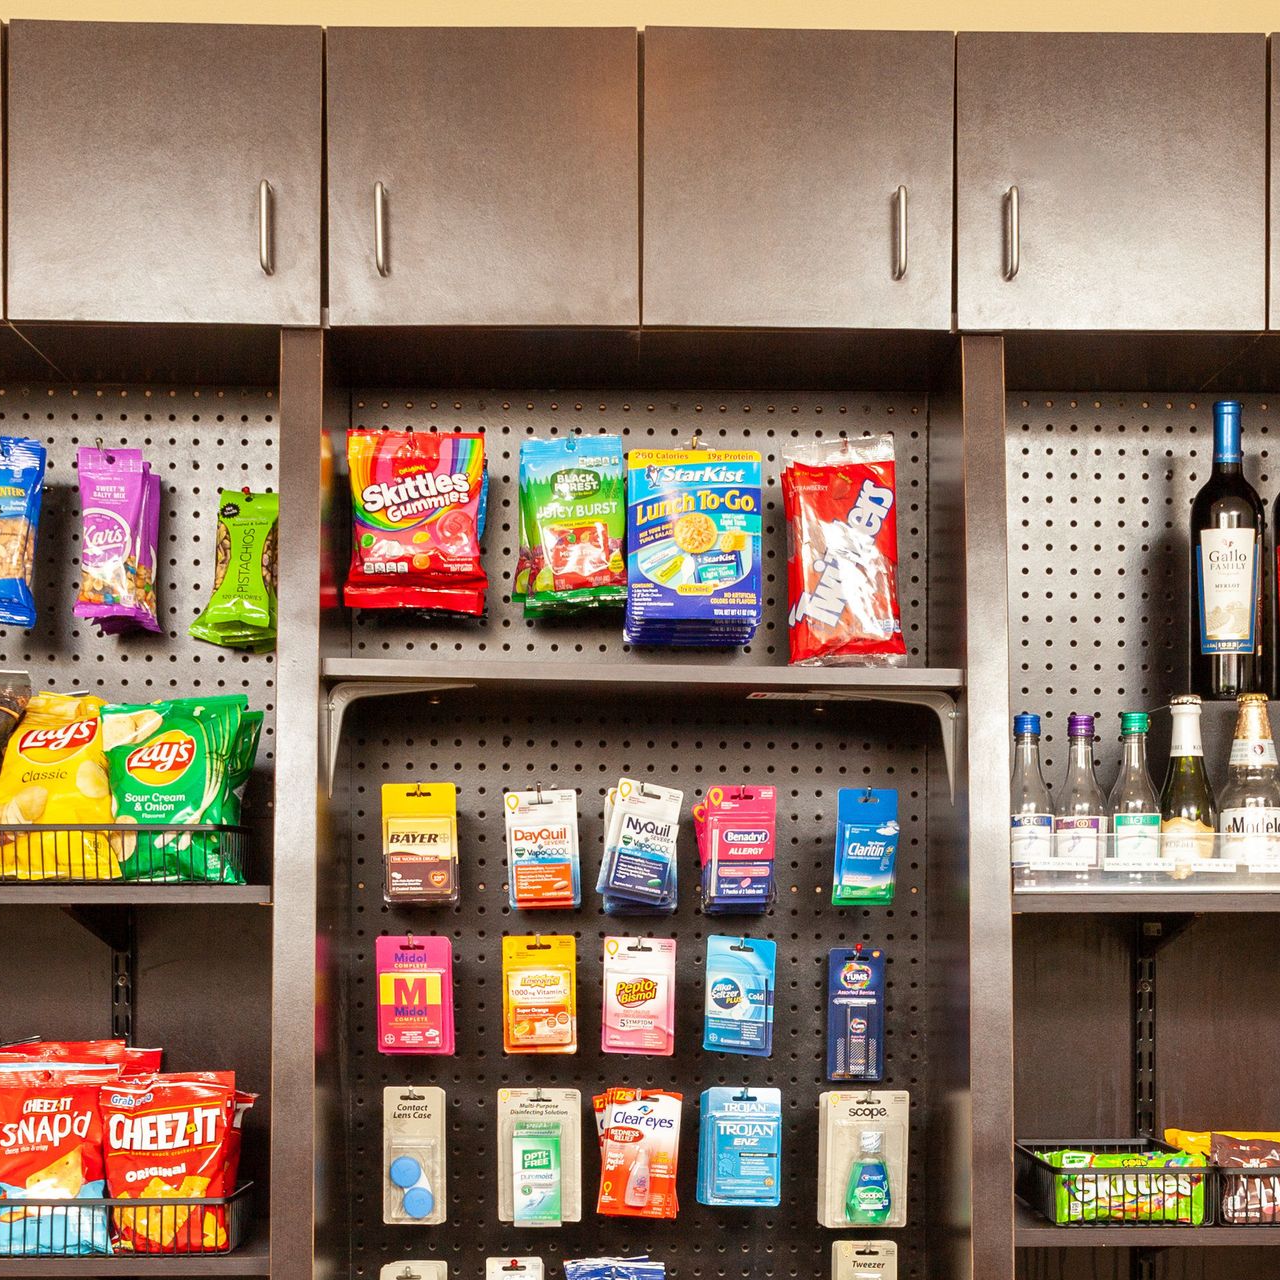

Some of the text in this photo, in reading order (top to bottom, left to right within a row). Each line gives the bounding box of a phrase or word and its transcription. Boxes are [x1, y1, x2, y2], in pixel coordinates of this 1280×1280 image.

[556, 474, 595, 483] BLACK
[662, 466, 745, 482] StarKist
[362, 472, 470, 512] Skittles
[386, 492, 470, 523] Gummies
[237, 529, 255, 592] PISTACHIOS
[1210, 563, 1247, 571] FAMILY
[21, 768, 68, 783] Classic
[125, 792, 186, 803] Sour Cream
[626, 816, 671, 836] NyQuil
[389, 833, 439, 843] BAYER
[514, 828, 567, 842] DayQuil
[726, 831, 766, 843] Benadryl
[848, 843, 884, 857] Claritin
[394, 954, 427, 963] Midol
[846, 973, 868, 981] TUMS
[711, 990, 740, 999] Seltzer
[394, 1008, 427, 1016] Midol
[397, 1104, 428, 1112] Contact
[723, 1102, 768, 1112] TROJAN
[393, 1112, 410, 1120] Lens
[849, 1108, 887, 1119] scope
[614, 1112, 674, 1130] Clear eyes
[718, 1123, 774, 1136] TROJAN
[733, 1138, 759, 1146] ENZ
[524, 1157, 549, 1168] FREE
[852, 1261, 885, 1269] Tweezer
